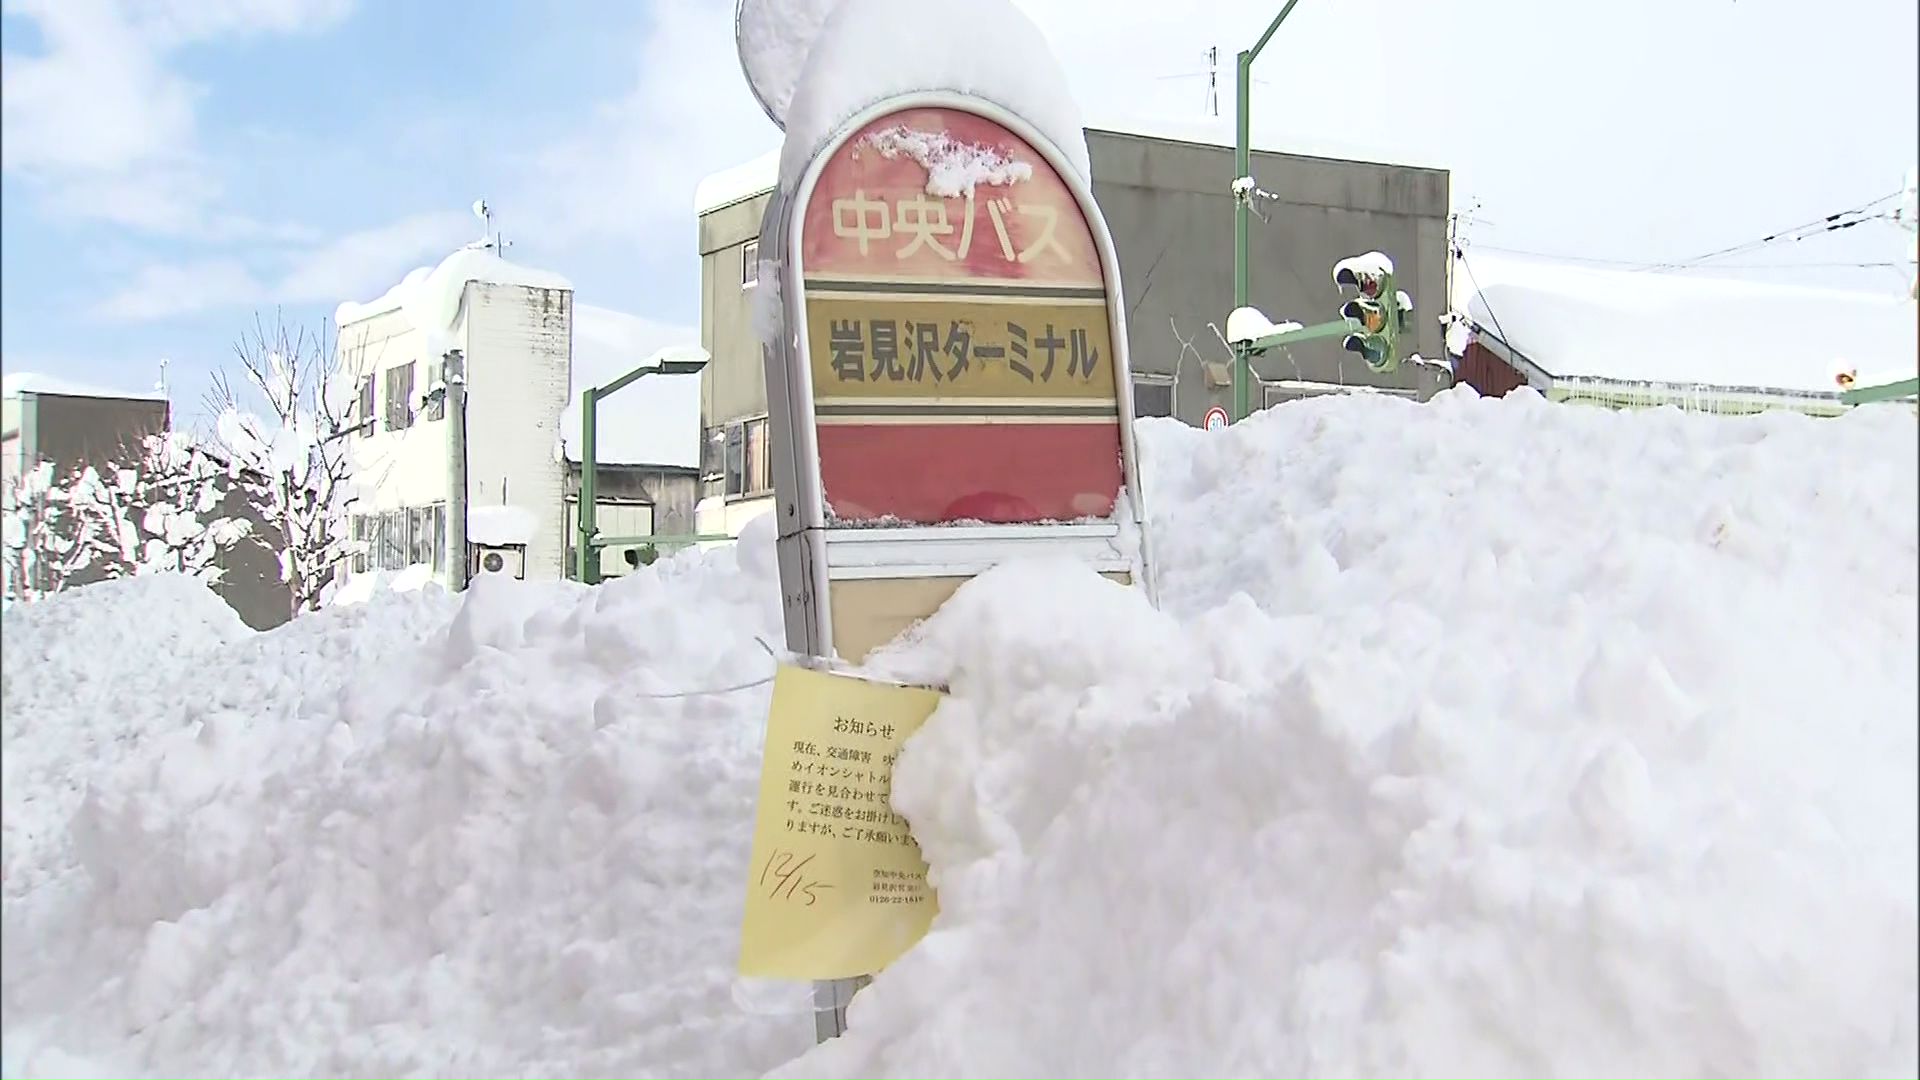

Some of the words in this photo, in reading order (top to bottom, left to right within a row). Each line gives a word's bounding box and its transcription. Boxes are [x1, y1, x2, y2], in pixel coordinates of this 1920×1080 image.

[832, 189, 1073, 264] 中央バス
[829, 318, 1099, 383] 岩見沢ターミナル
[833, 716, 896, 740] お知らせ
[788, 779, 890, 805] 運行を見合わせて
[760, 848, 836, 906] 12/15
